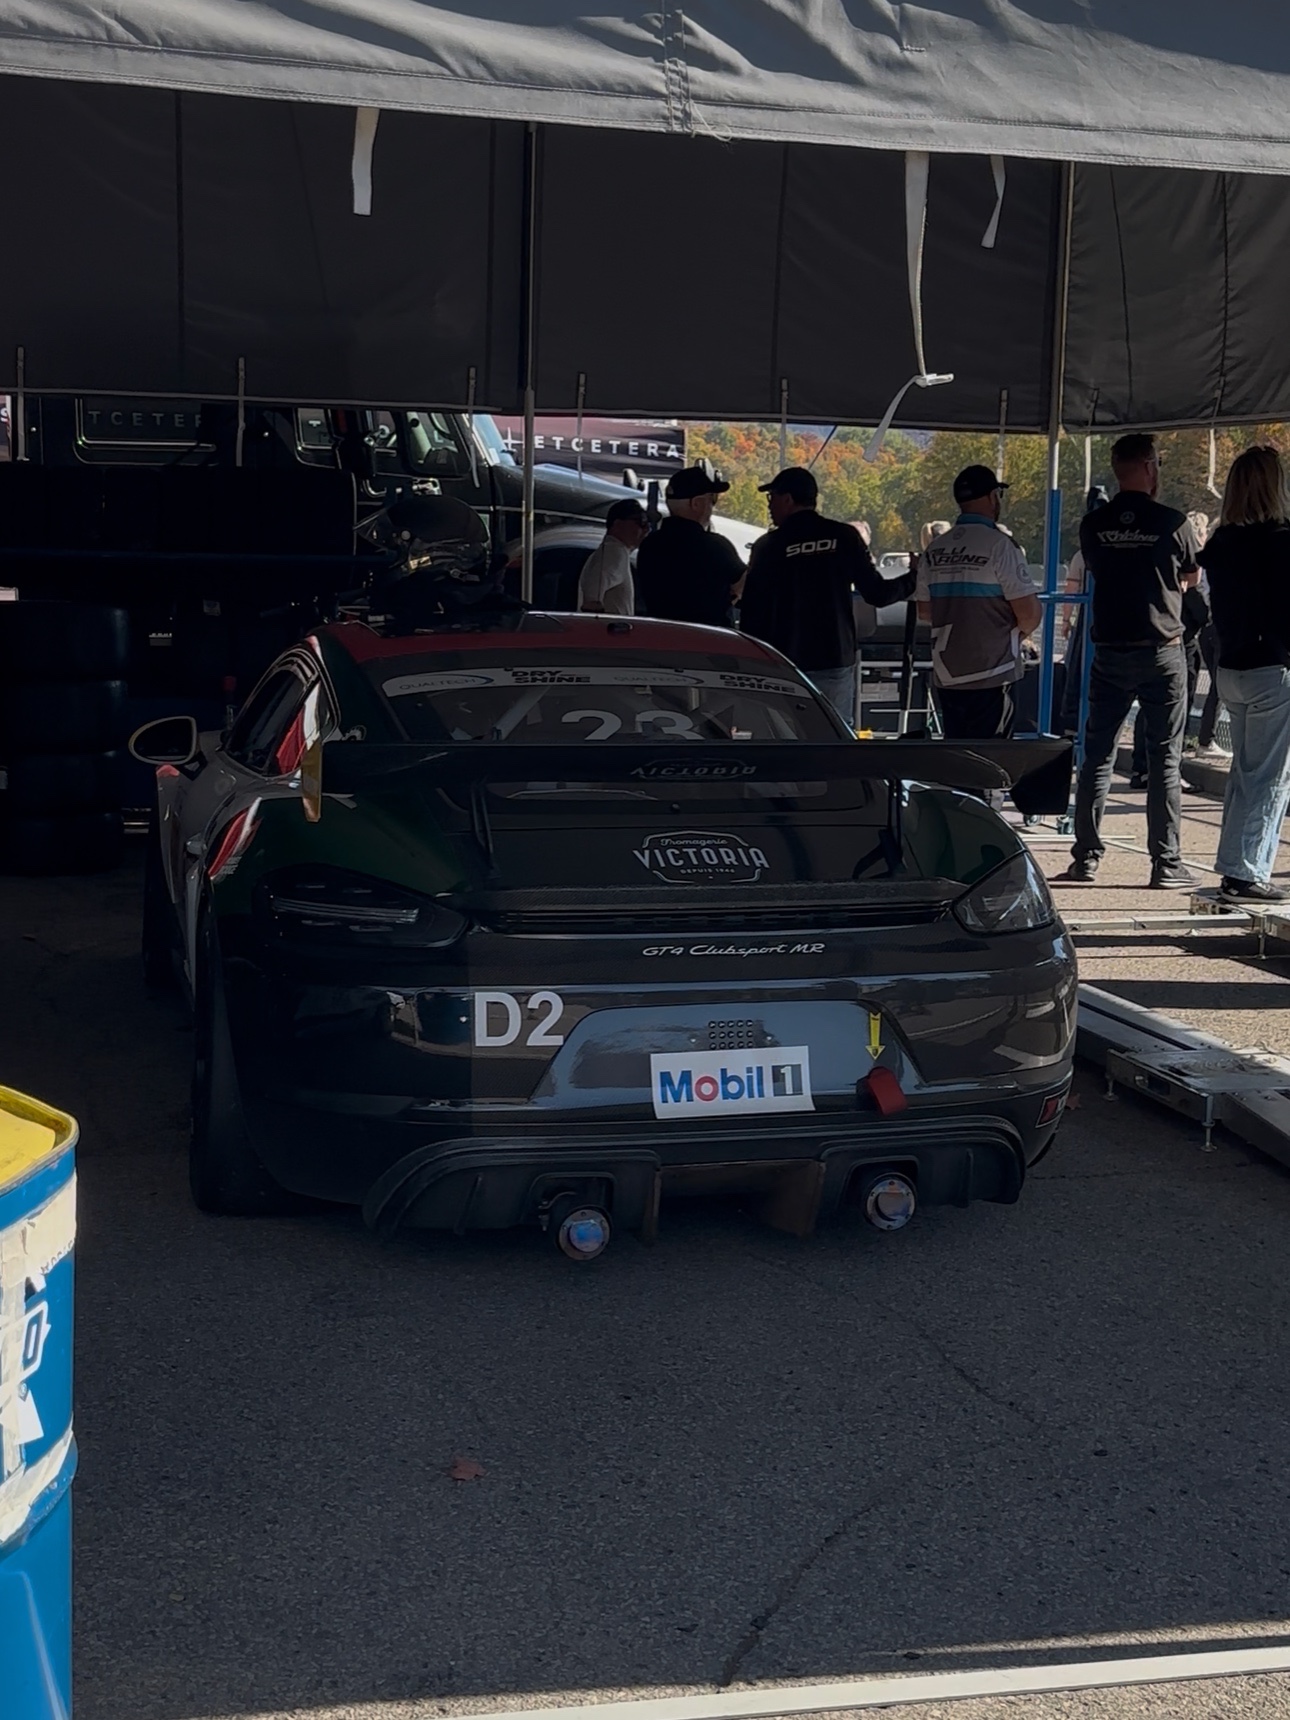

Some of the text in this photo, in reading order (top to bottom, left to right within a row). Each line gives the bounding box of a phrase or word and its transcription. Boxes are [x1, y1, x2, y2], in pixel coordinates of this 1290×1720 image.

[533, 435, 680, 458] ETCETERA
[785, 538, 838, 558] SODI
[514, 676, 591, 684] SHINE
[719, 674, 766, 683] DRY
[724, 680, 796, 693] SHINE
[660, 837, 729, 847] Fromagerie
[632, 847, 770, 870] VICTORIA
[680, 867, 714, 875] DEPUIS
[642, 942, 826, 958] GT4 Clubsport MR
[474, 990, 565, 1047] D2
[659, 1066, 765, 1104] Mobil
